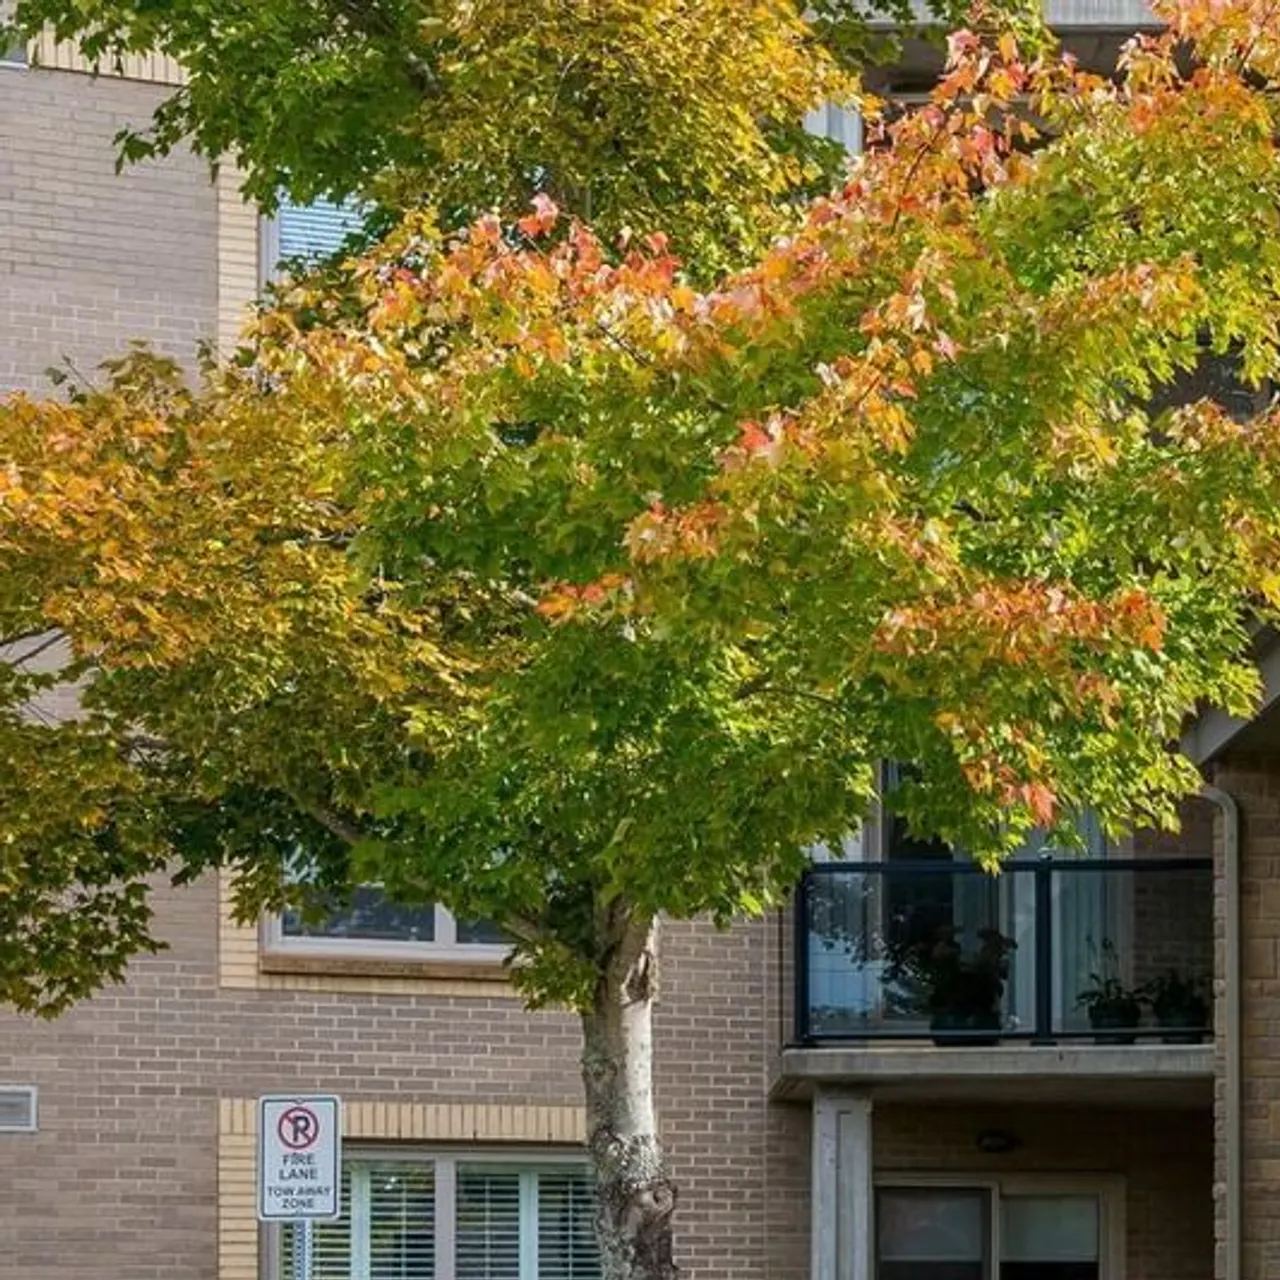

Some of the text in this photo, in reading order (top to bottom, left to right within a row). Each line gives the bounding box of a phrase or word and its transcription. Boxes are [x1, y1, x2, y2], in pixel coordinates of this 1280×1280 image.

[281, 1153, 315, 1165] FIRE
[279, 1169, 318, 1180] LANE
[268, 1186, 294, 1197] TOW
[282, 1198, 315, 1209] ZONE
